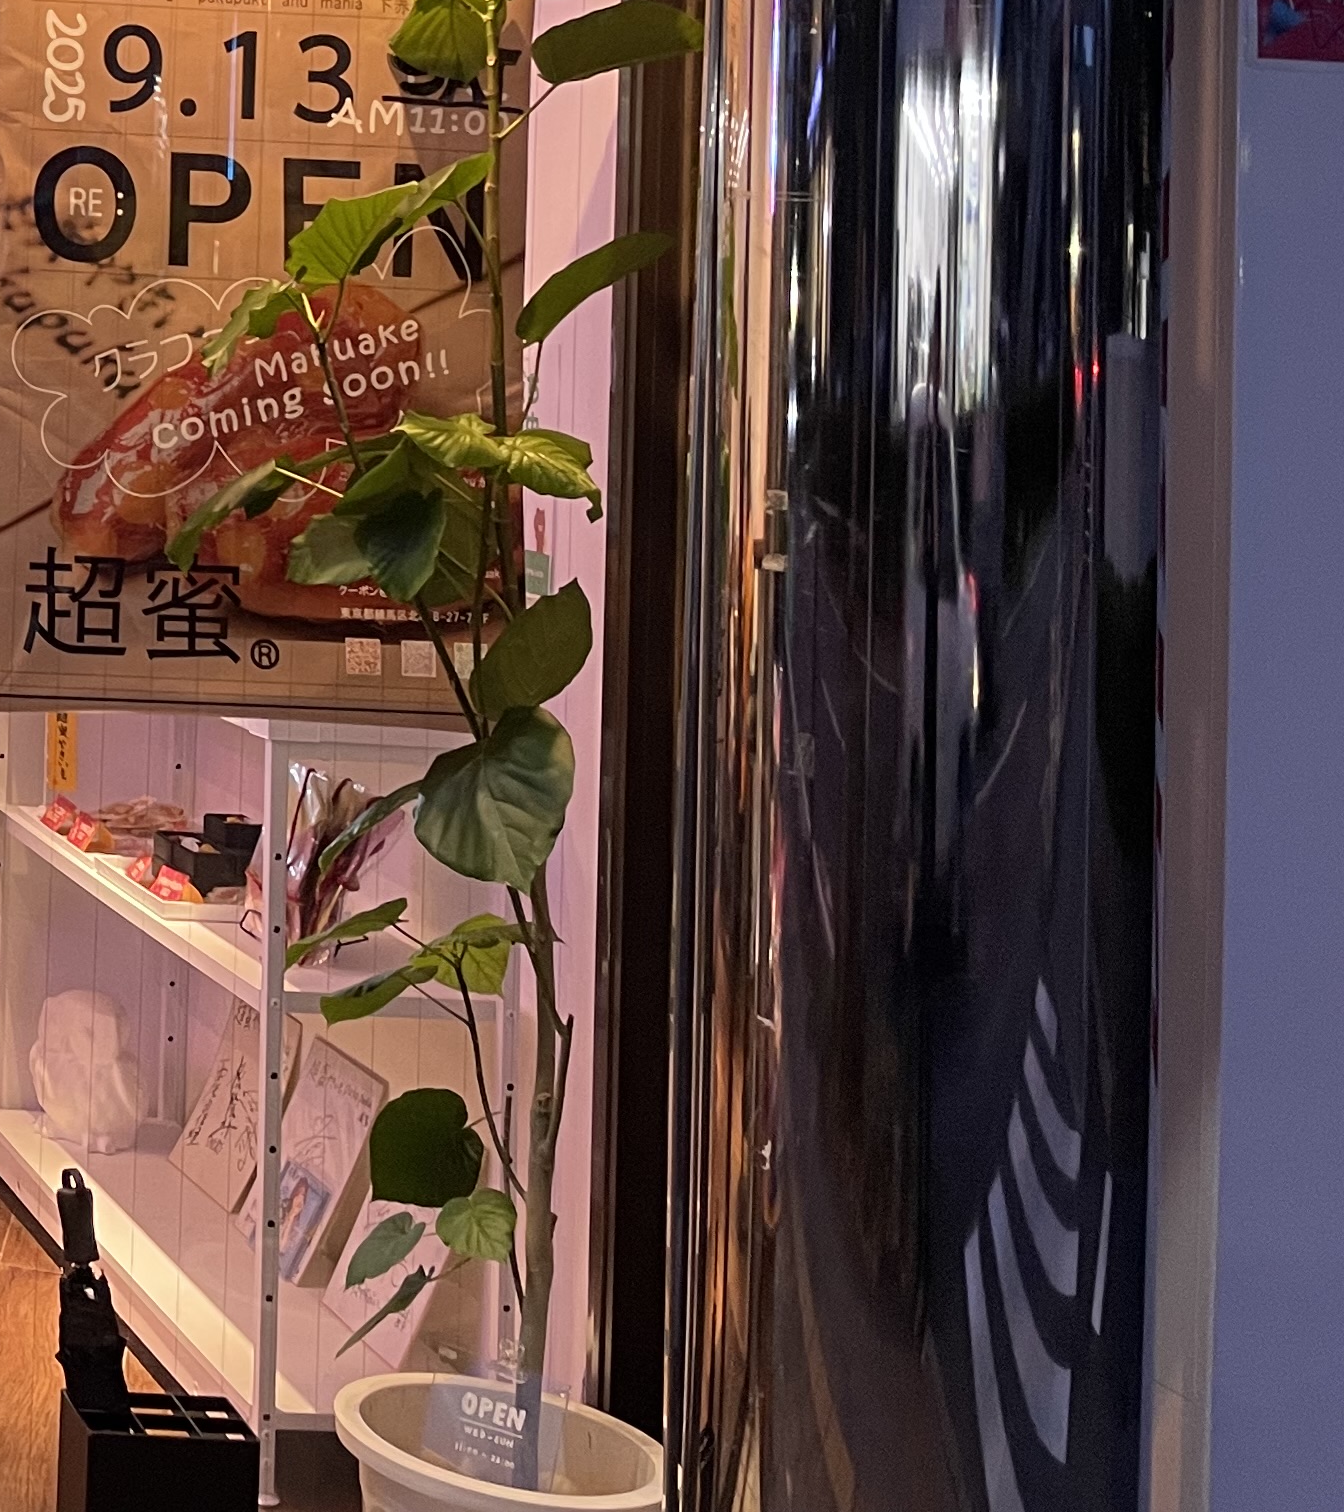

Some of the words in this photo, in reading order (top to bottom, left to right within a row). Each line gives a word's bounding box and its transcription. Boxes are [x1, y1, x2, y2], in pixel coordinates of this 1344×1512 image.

[42, 8, 87, 123] 2025
[103, 23, 353, 124] 9.13
[33, 144, 487, 283] OPEN
[151, 388, 302, 450] coming
[461, 1391, 527, 1432] OPEN
